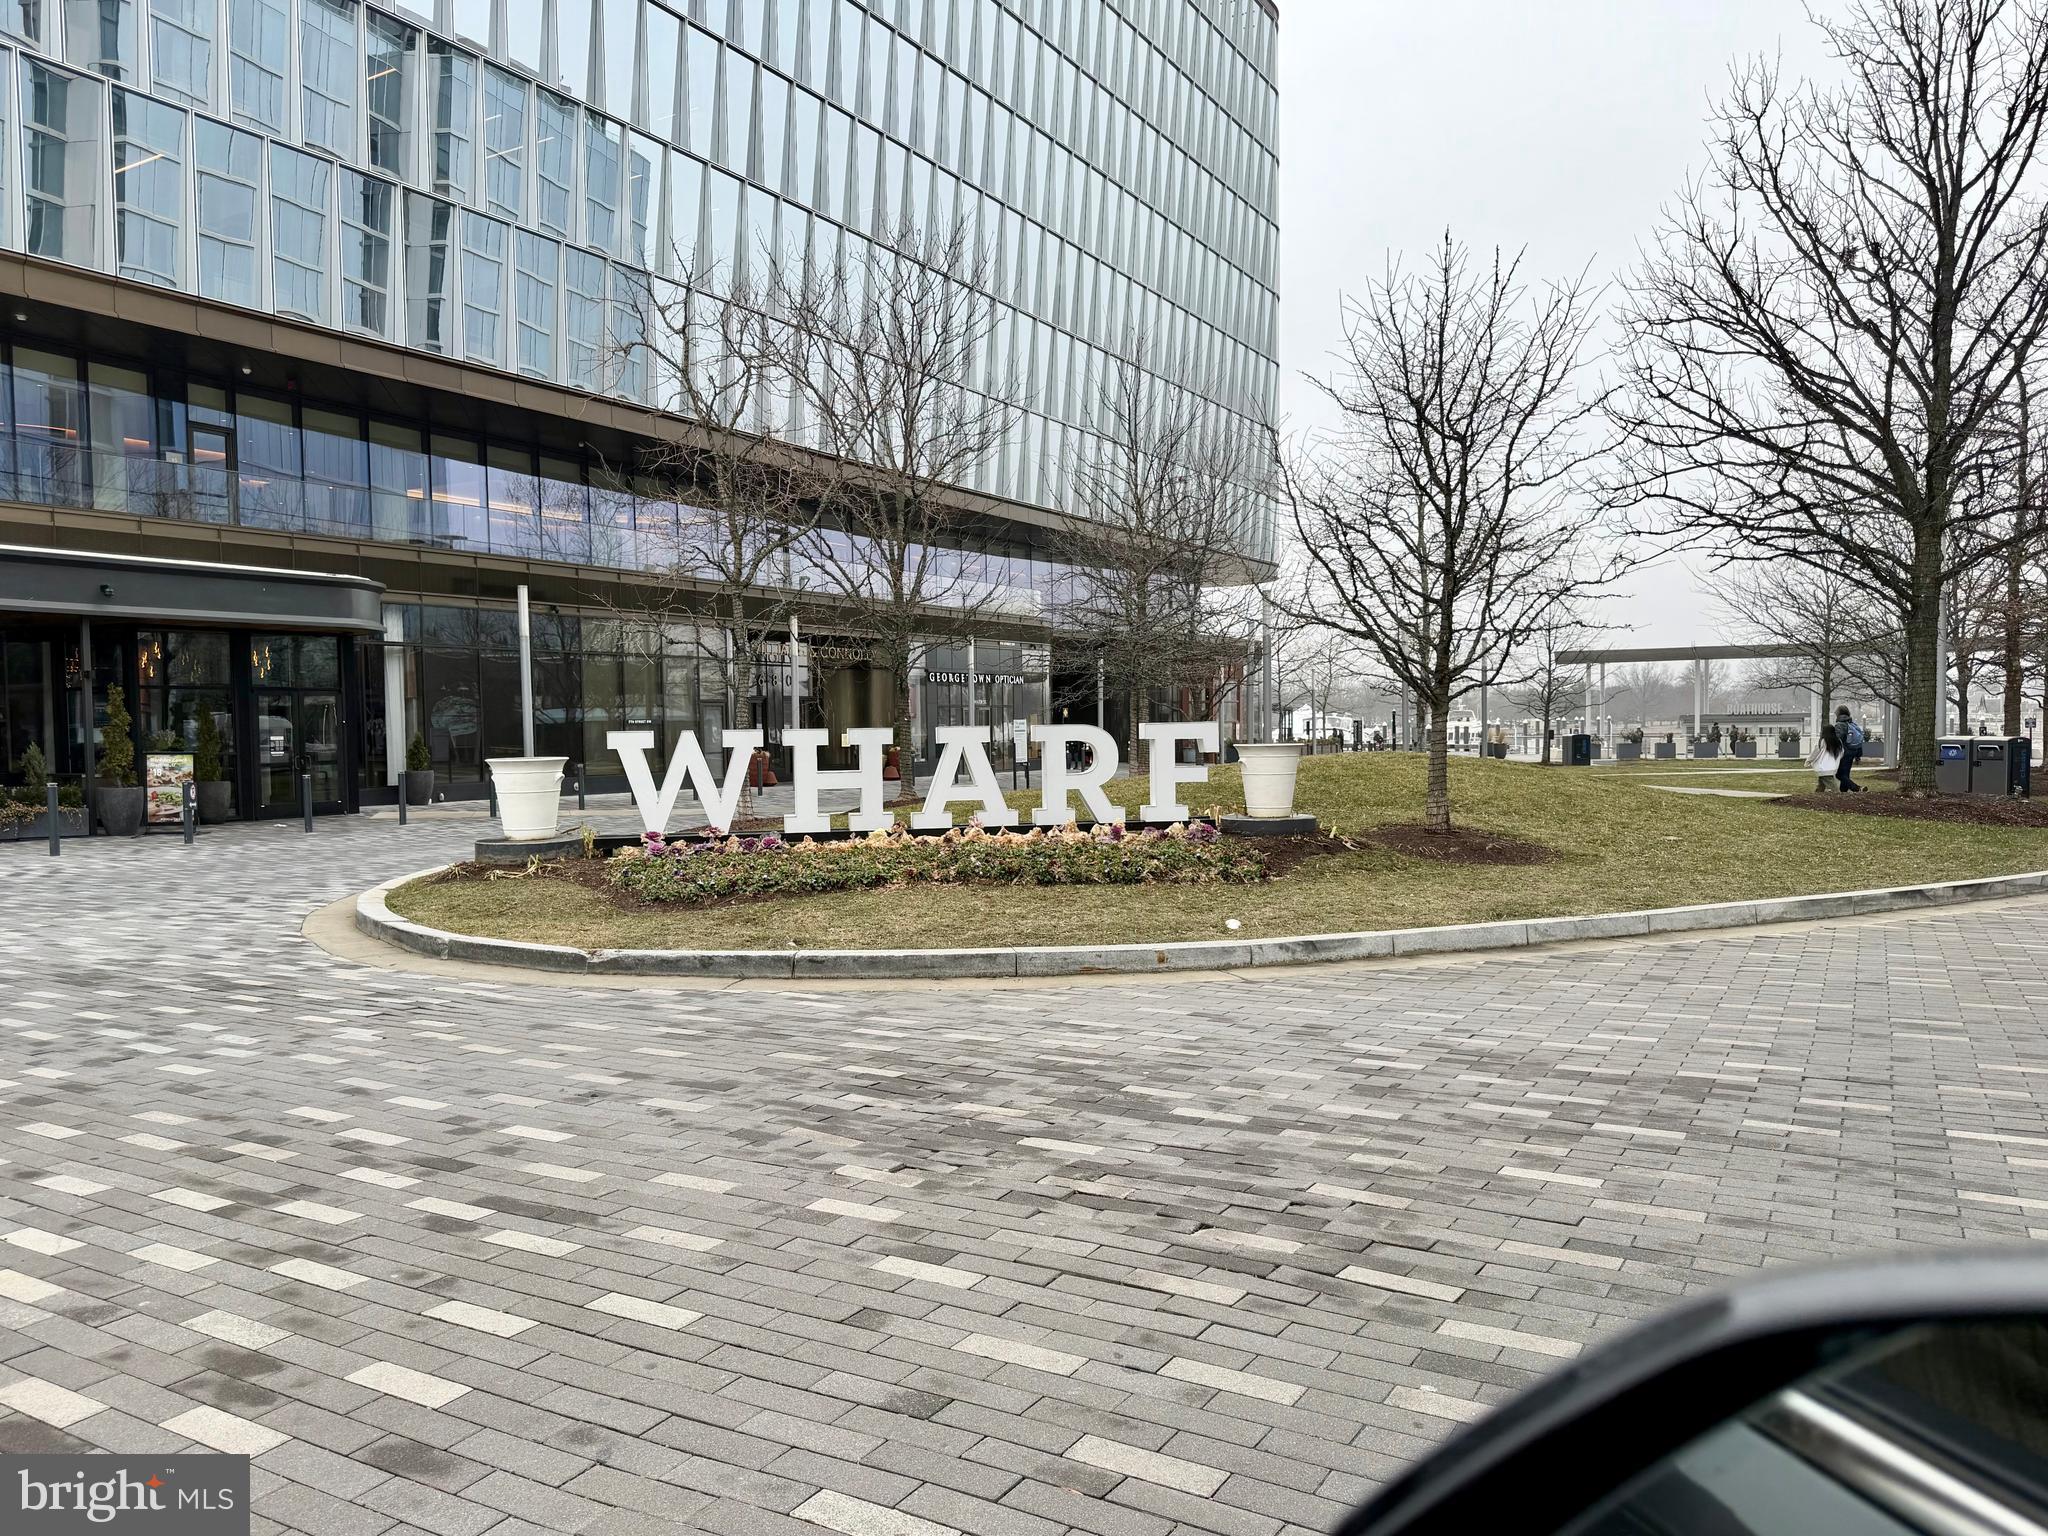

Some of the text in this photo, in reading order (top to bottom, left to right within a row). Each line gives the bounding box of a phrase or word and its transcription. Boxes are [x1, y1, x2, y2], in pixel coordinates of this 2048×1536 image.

[994, 674, 1024, 685] OPTICIAN
[1726, 703, 1783, 715] BOATHOUSE
[606, 721, 1220, 836] WHARF
